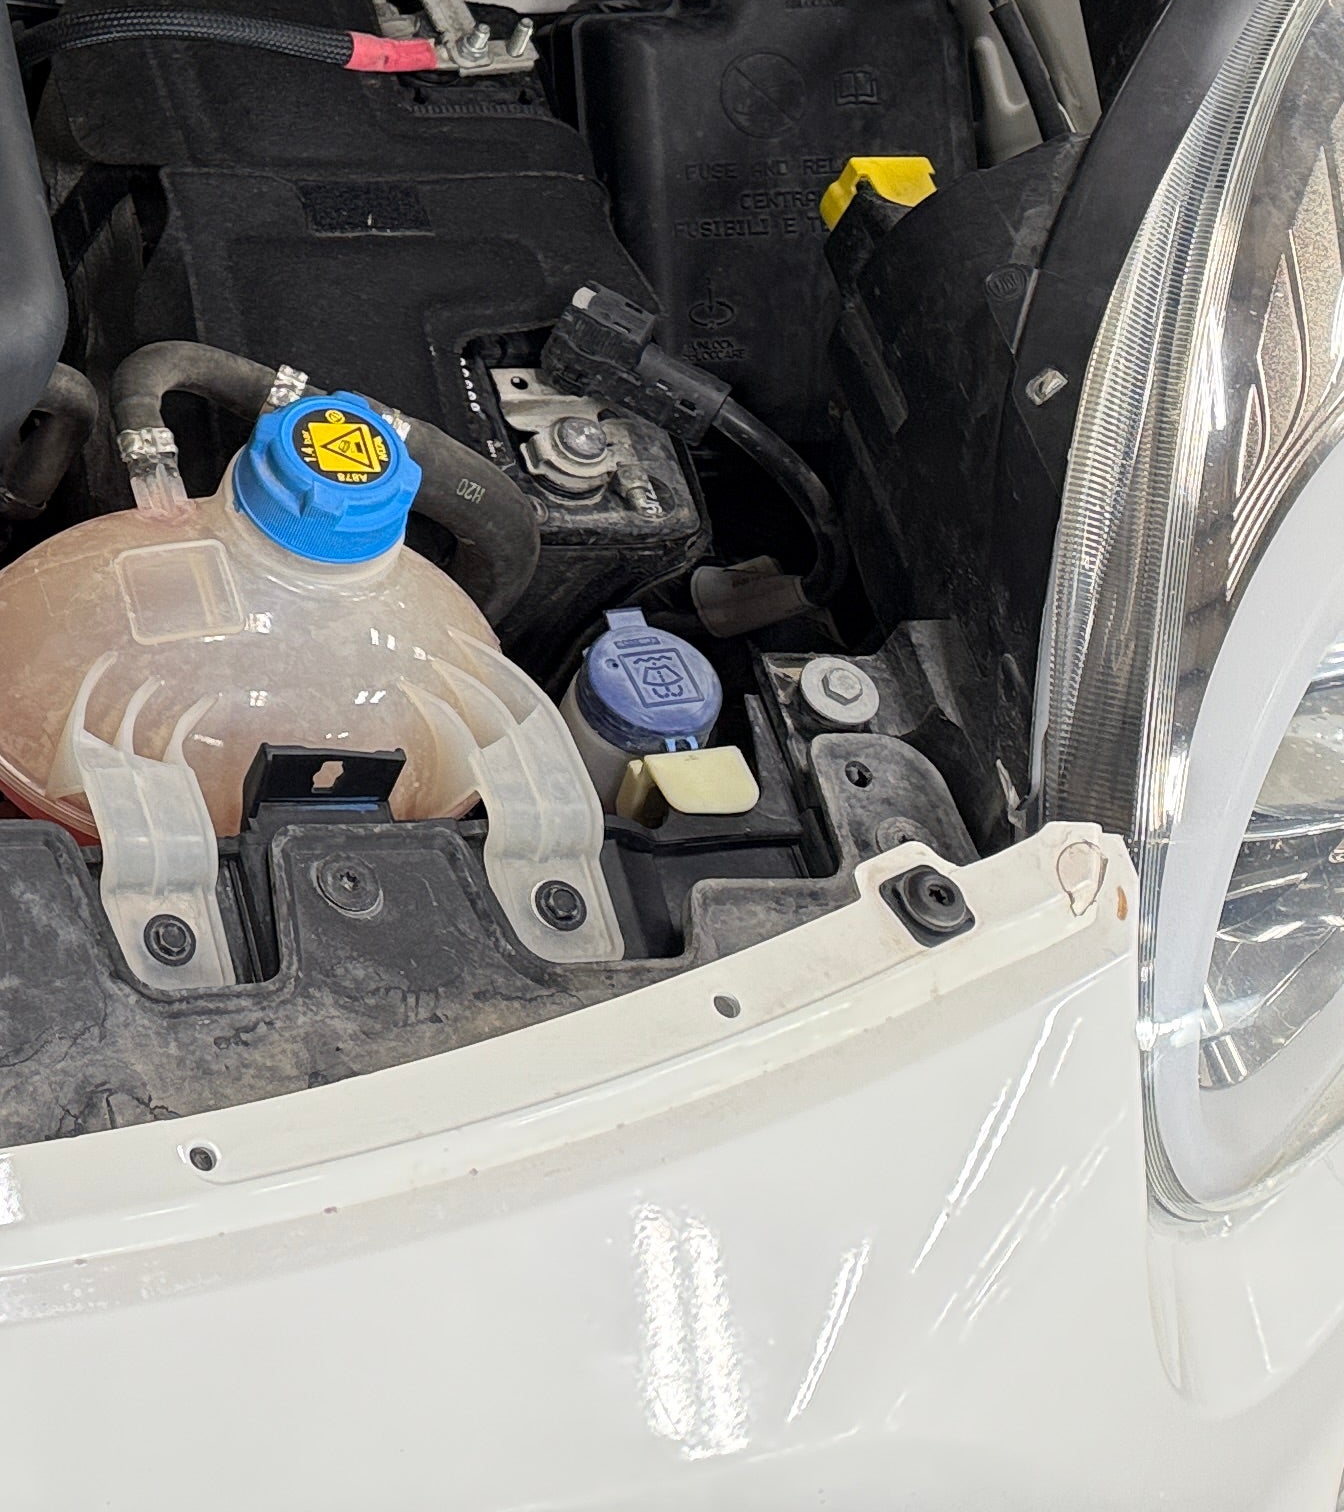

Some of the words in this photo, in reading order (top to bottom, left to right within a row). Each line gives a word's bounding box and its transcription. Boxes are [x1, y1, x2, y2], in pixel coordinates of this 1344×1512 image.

[684, 162, 738, 180] FUSE
[802, 158, 845, 176] REL
[738, 191, 823, 210] CENTRA
